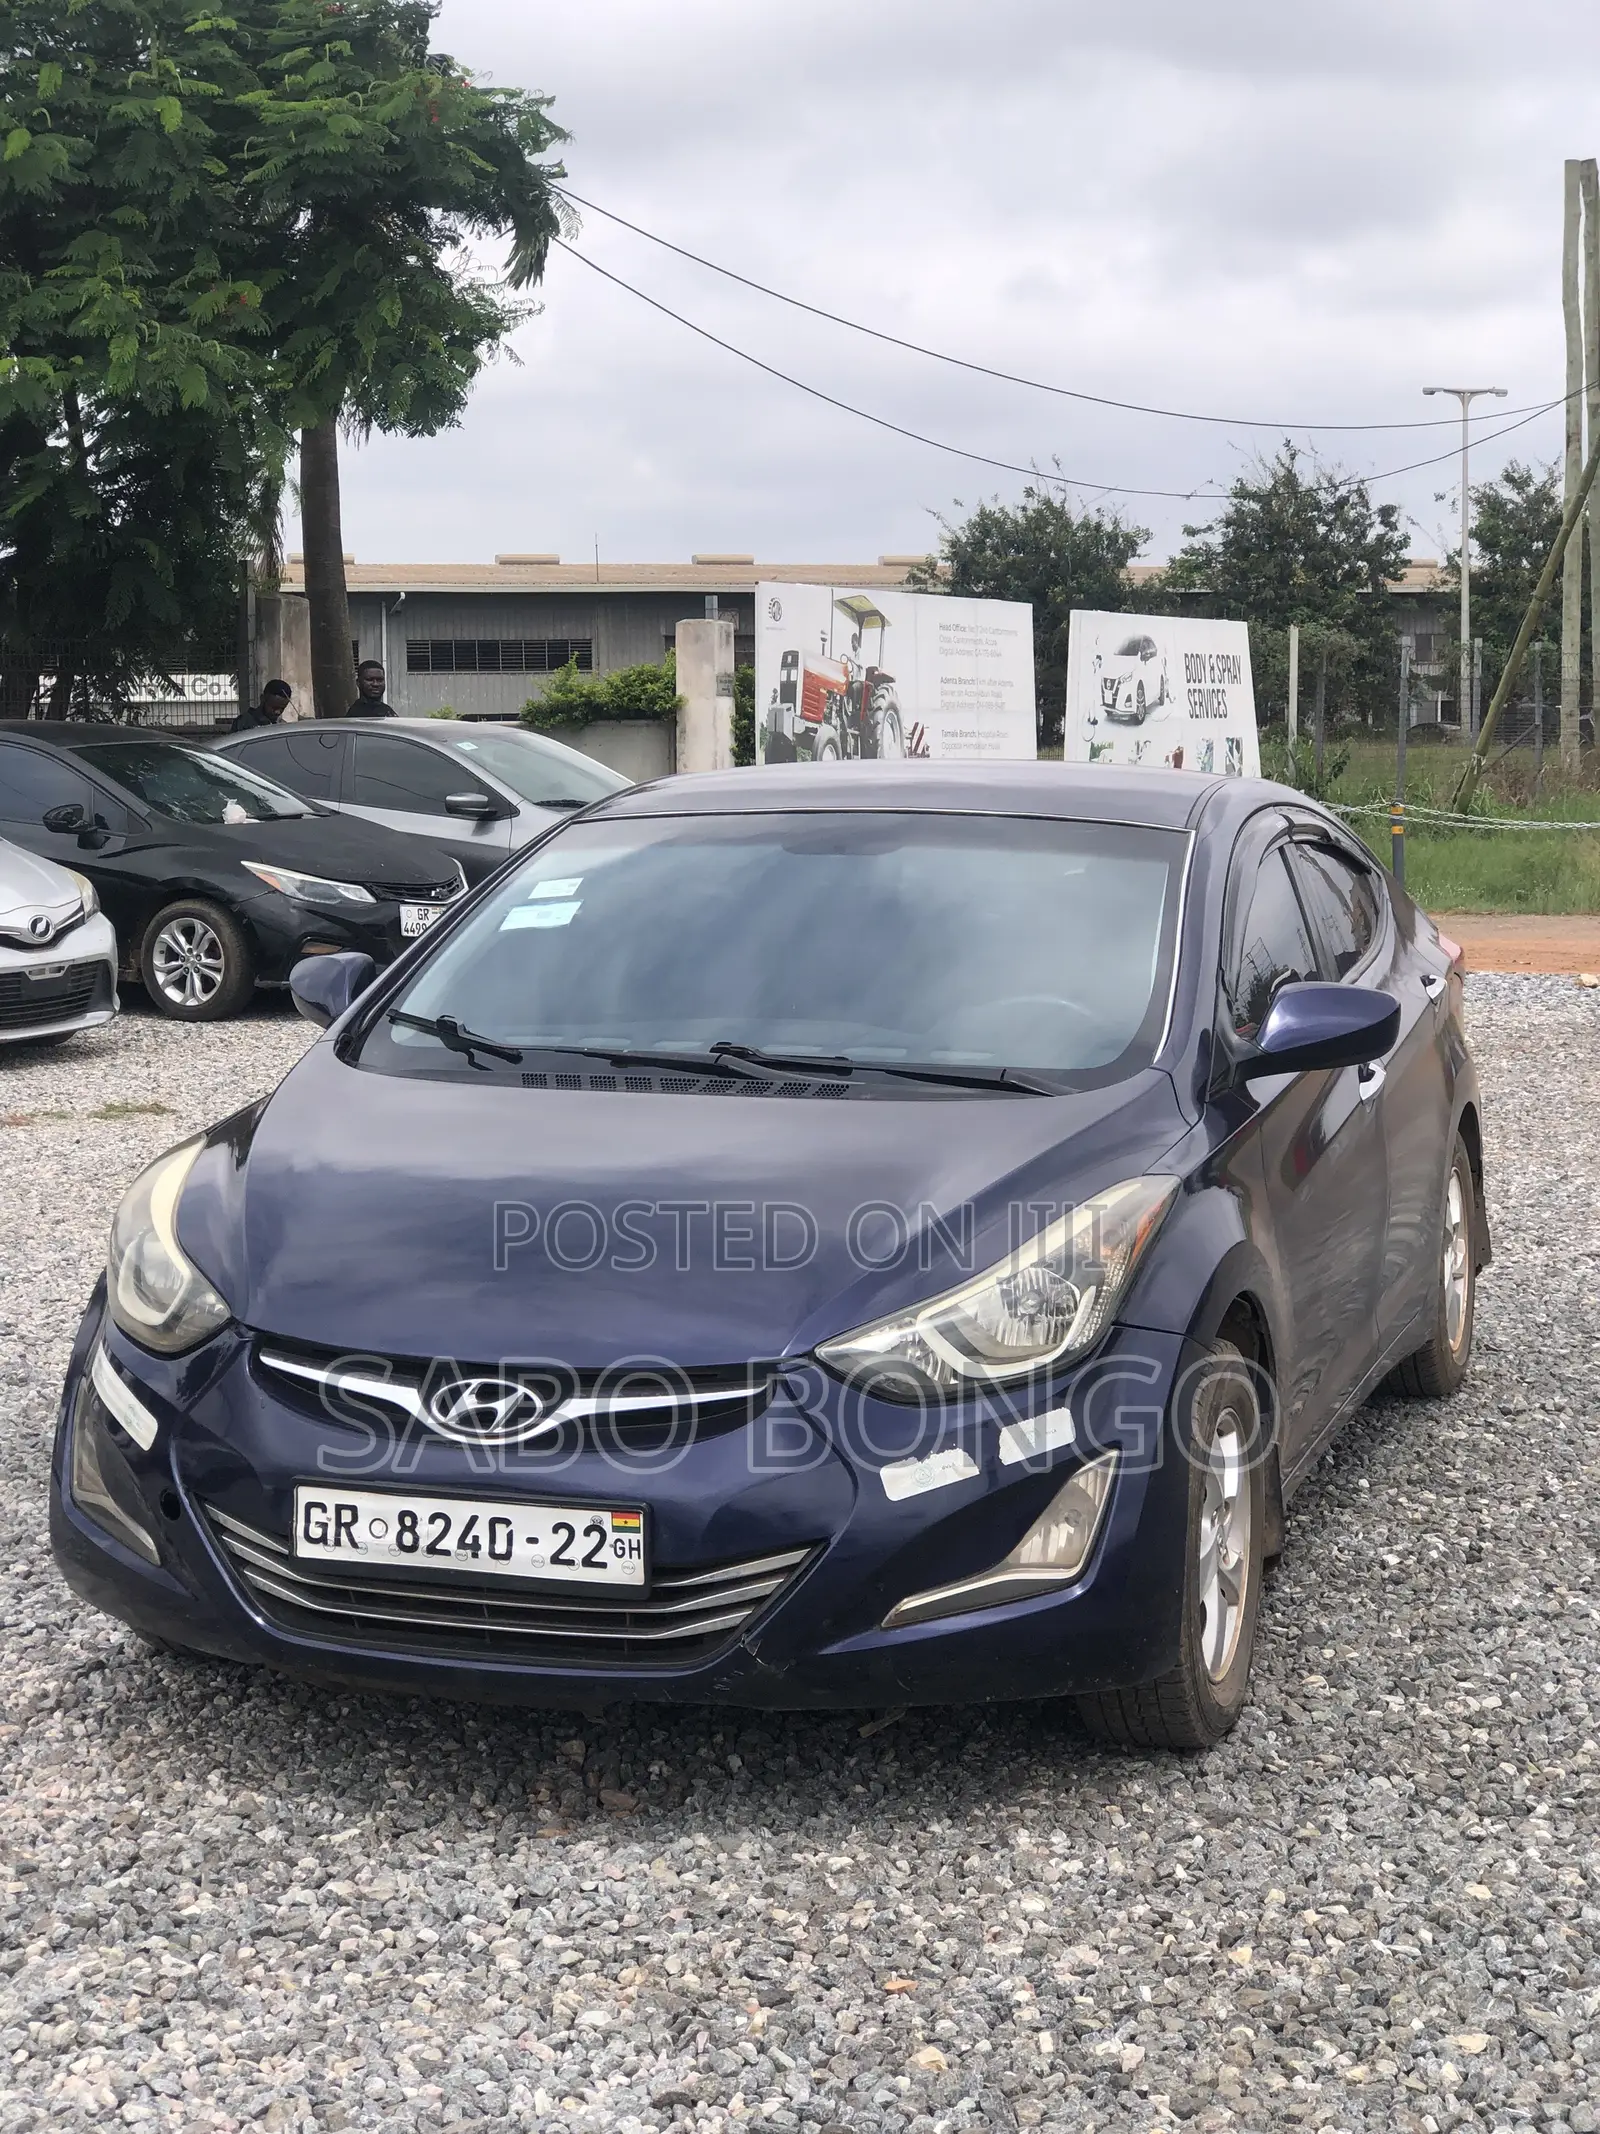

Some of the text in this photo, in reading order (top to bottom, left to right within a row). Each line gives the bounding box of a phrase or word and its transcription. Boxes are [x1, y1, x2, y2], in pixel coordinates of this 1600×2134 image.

[1184, 653, 1242, 685] BODY & SPRAY
[191, 676, 228, 697] Co.
[1187, 688, 1228, 719] SERVICES
[417, 907, 430, 921] GR
[302, 1501, 359, 1549] GR
[613, 1537, 641, 1560] GH
